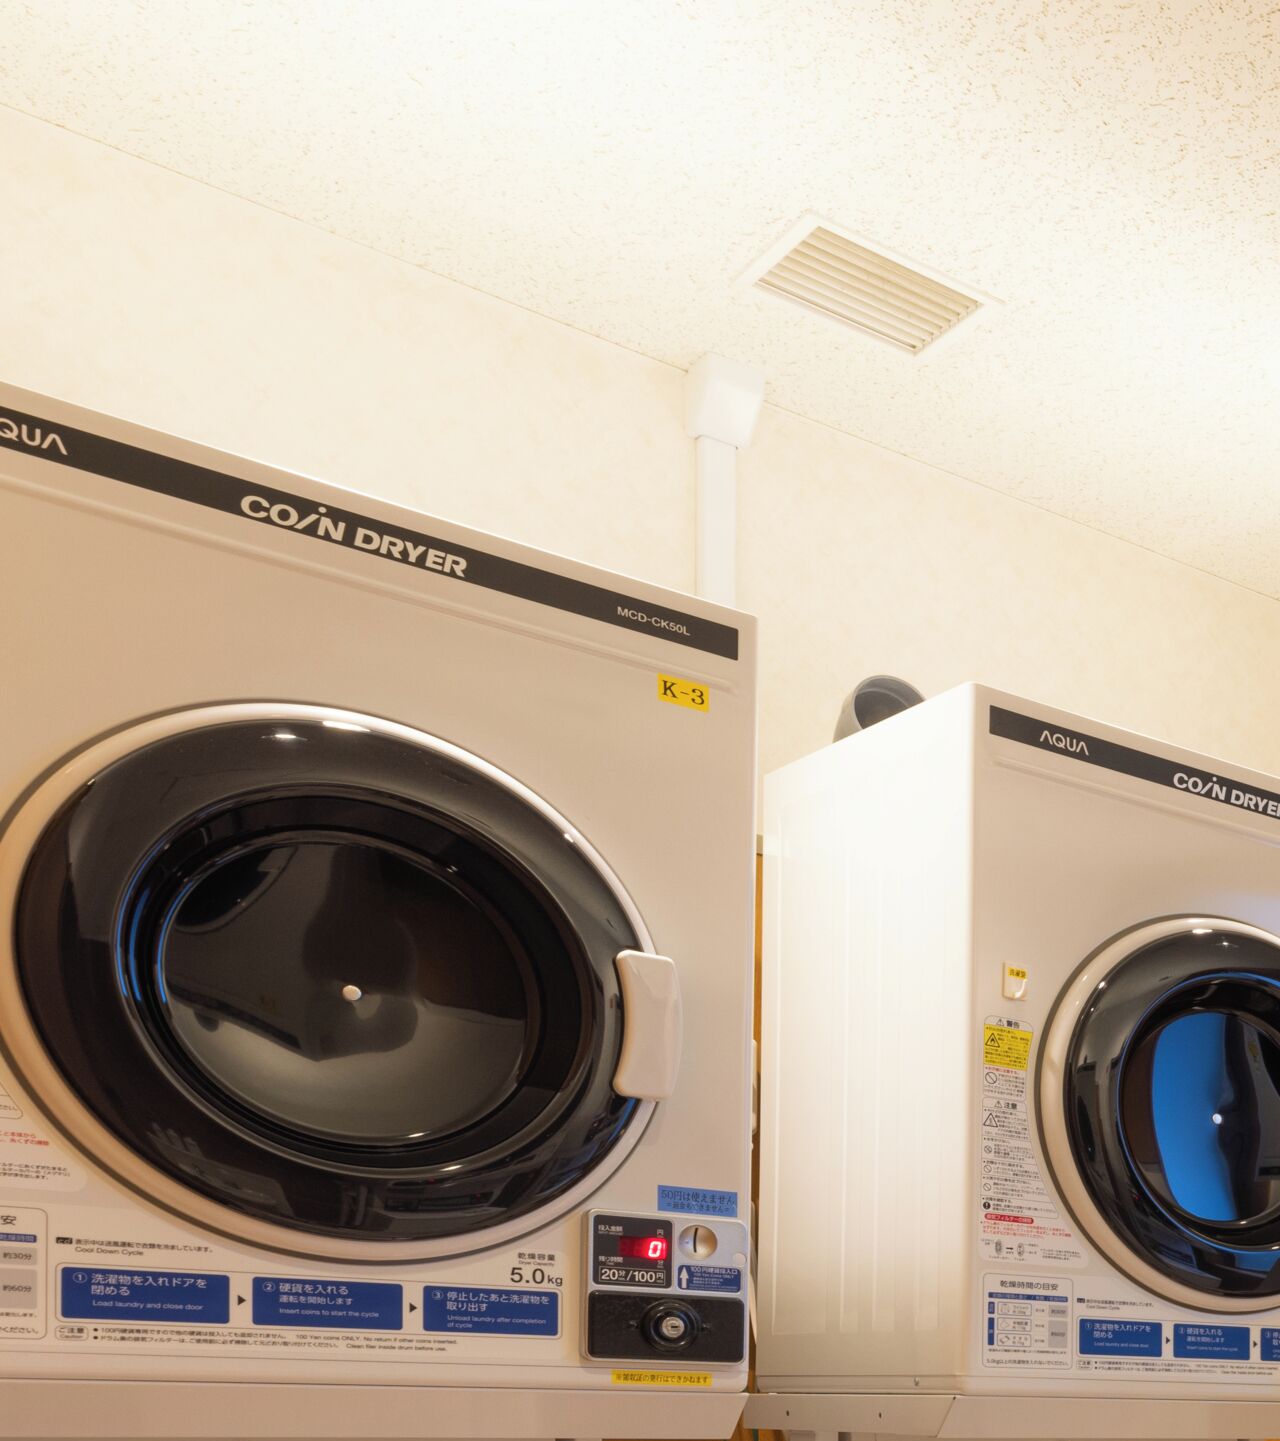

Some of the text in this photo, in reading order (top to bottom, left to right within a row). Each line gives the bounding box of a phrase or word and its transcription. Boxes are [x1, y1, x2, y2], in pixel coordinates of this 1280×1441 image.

[240, 495, 467, 577] COIN DRYER
[617, 606, 691, 636] MCD-CK50L
[661, 679, 706, 706] K-3
[1040, 730, 1089, 756] AQUA
[1173, 772, 1225, 801] COIN
[96, 1247, 120, 1255] Down
[648, 1241, 662, 1258] 0
[517, 1252, 556, 1262] 乾燥容量
[91, 1273, 207, 1289] 洗濯物を入れドアを
[1000, 1280, 1059, 1291] 乾燥時間の目安
[91, 1284, 130, 1296] 閉める
[279, 1283, 349, 1295] 硬貨を入れる
[279, 1295, 353, 1305] 運転を開始します
[447, 1292, 549, 1305] 停止したあと洗濯物を
[93, 1299, 113, 1307] Load
[115, 1301, 144, 1310] laundry
[185, 1303, 203, 1311] door
[447, 1301, 488, 1312] 取り出す
[472, 1316, 495, 1324] laundry
[512, 1317, 546, 1325] completion
